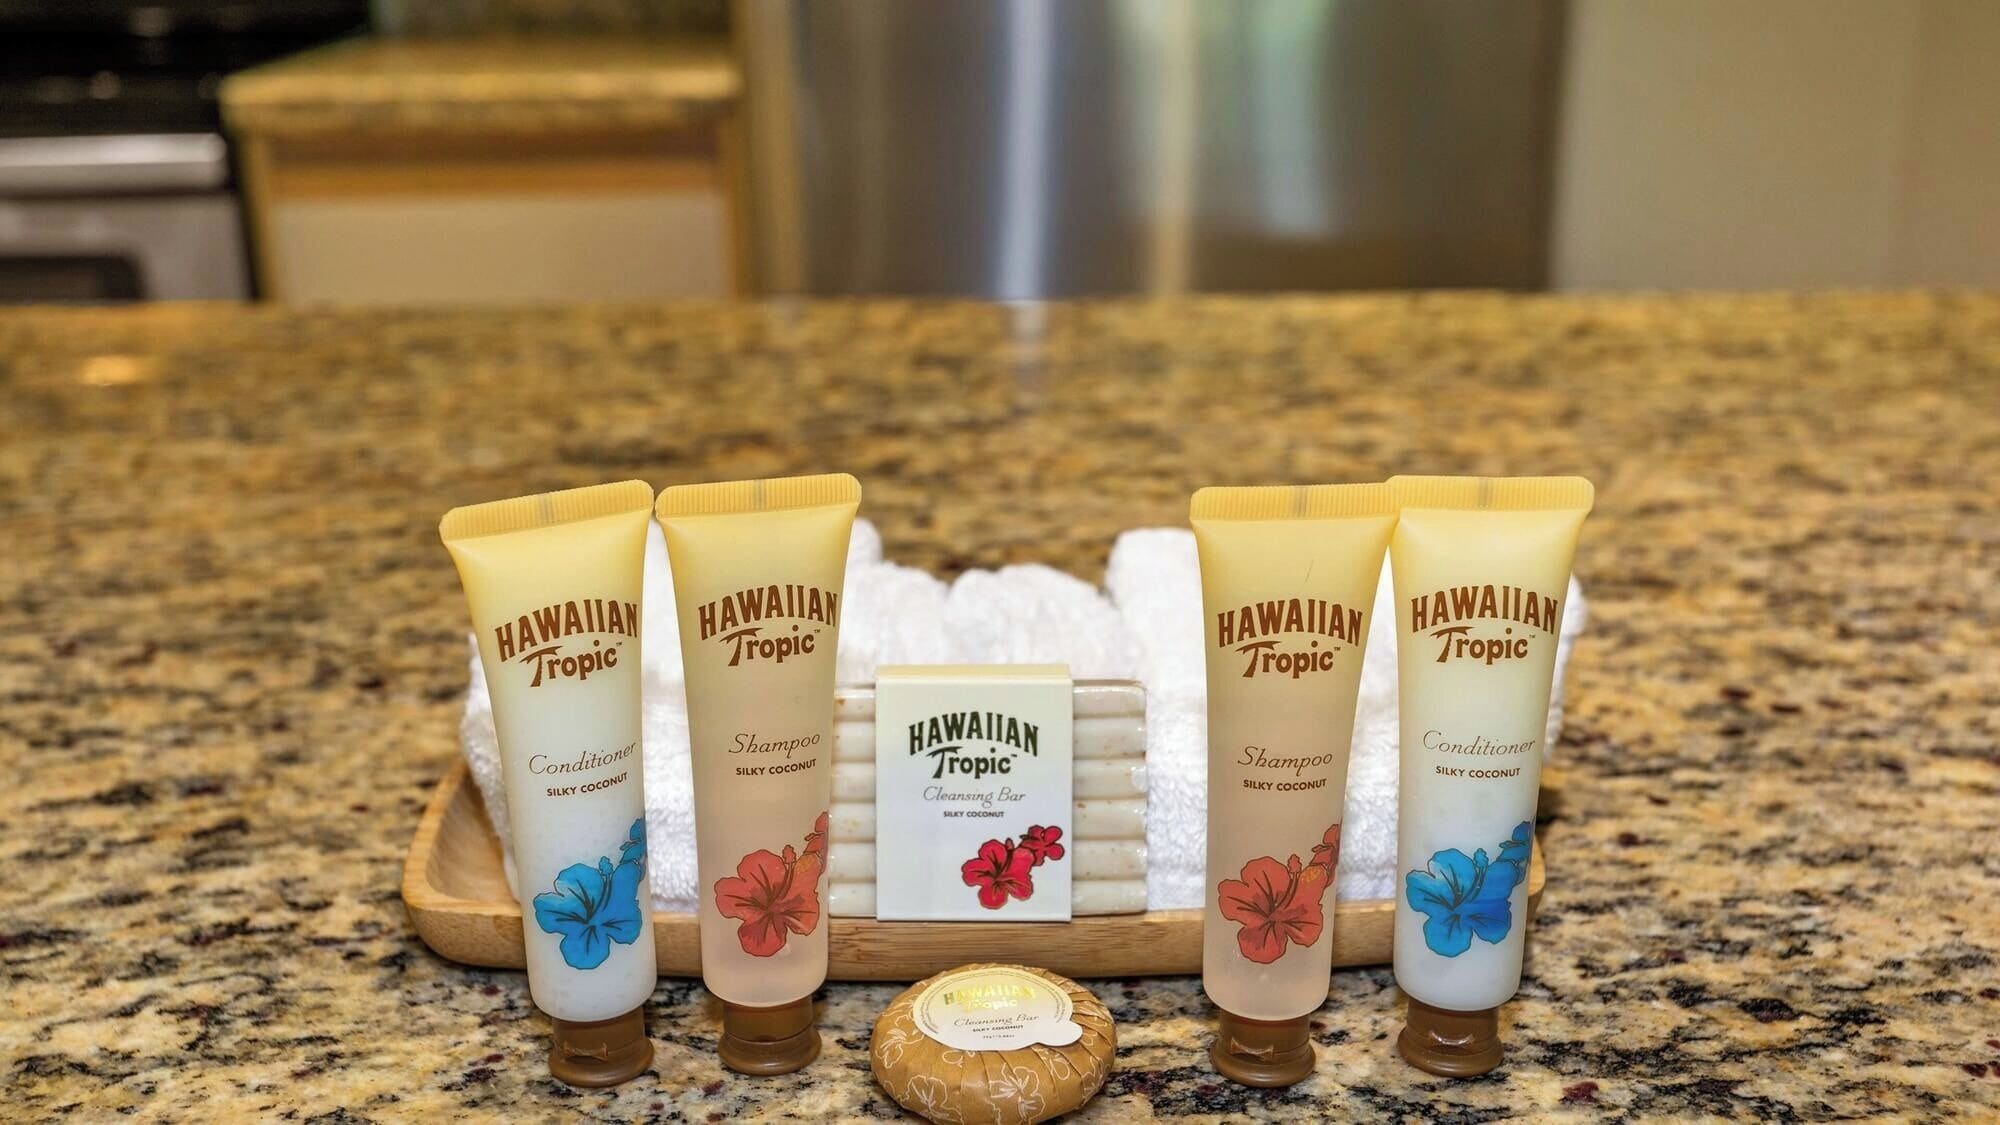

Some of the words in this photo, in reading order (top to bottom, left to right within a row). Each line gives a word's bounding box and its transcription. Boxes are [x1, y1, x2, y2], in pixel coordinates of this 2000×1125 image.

[699, 584, 838, 640] HAWAIIAN
[1411, 584, 1558, 634] HAWAIIAN
[495, 599, 638, 662] HAWAIIAN
[1217, 598, 1363, 648] HAWAIIAN
[728, 732, 821, 758] Shampoo
[908, 711, 1039, 757] HAWAIIAN
[1423, 730, 1536, 756] Conditioner
[528, 741, 636, 776] Conditioner
[735, 766, 765, 776] SILKY
[768, 758, 817, 774] COCONUT
[1237, 746, 1333, 777] Shampoo
[1435, 765, 1465, 777] SILKY
[1468, 767, 1521, 778] COCONUT
[546, 786, 577, 797] SILKY
[580, 773, 628, 793] COCONUT
[923, 786, 994, 808] Cleansing
[996, 786, 1026, 802] Bar
[1243, 778, 1273, 791] SILKY
[1276, 778, 1327, 791] COCONUT
[954, 1017, 1013, 1027] Cleansing
[1016, 1013, 1040, 1022] Bar
